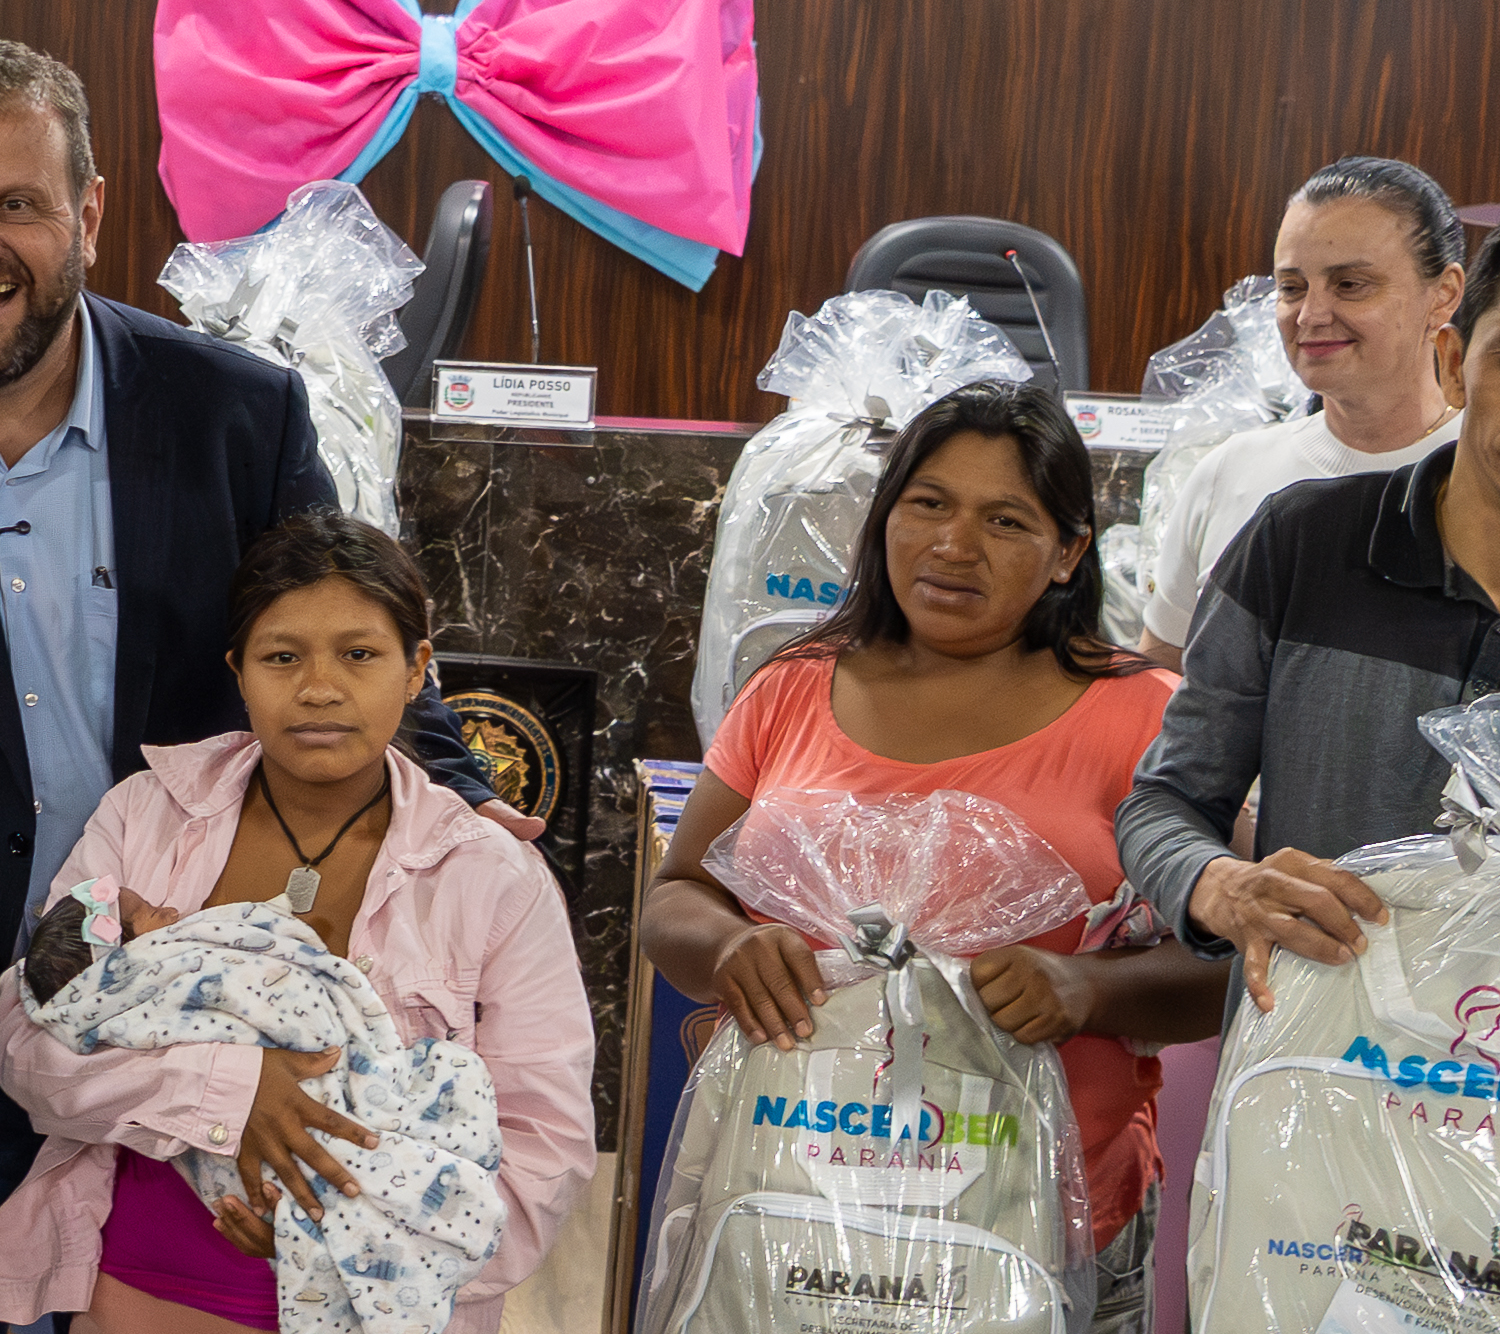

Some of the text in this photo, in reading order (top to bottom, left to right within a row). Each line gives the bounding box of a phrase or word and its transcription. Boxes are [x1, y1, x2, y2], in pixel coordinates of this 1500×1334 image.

[493, 376, 571, 392] LÍDIA POSSO
[766, 572, 849, 606] NAS
[807, 1144, 964, 1175] PARANÁ
[786, 1266, 929, 1302] PARANÁ
